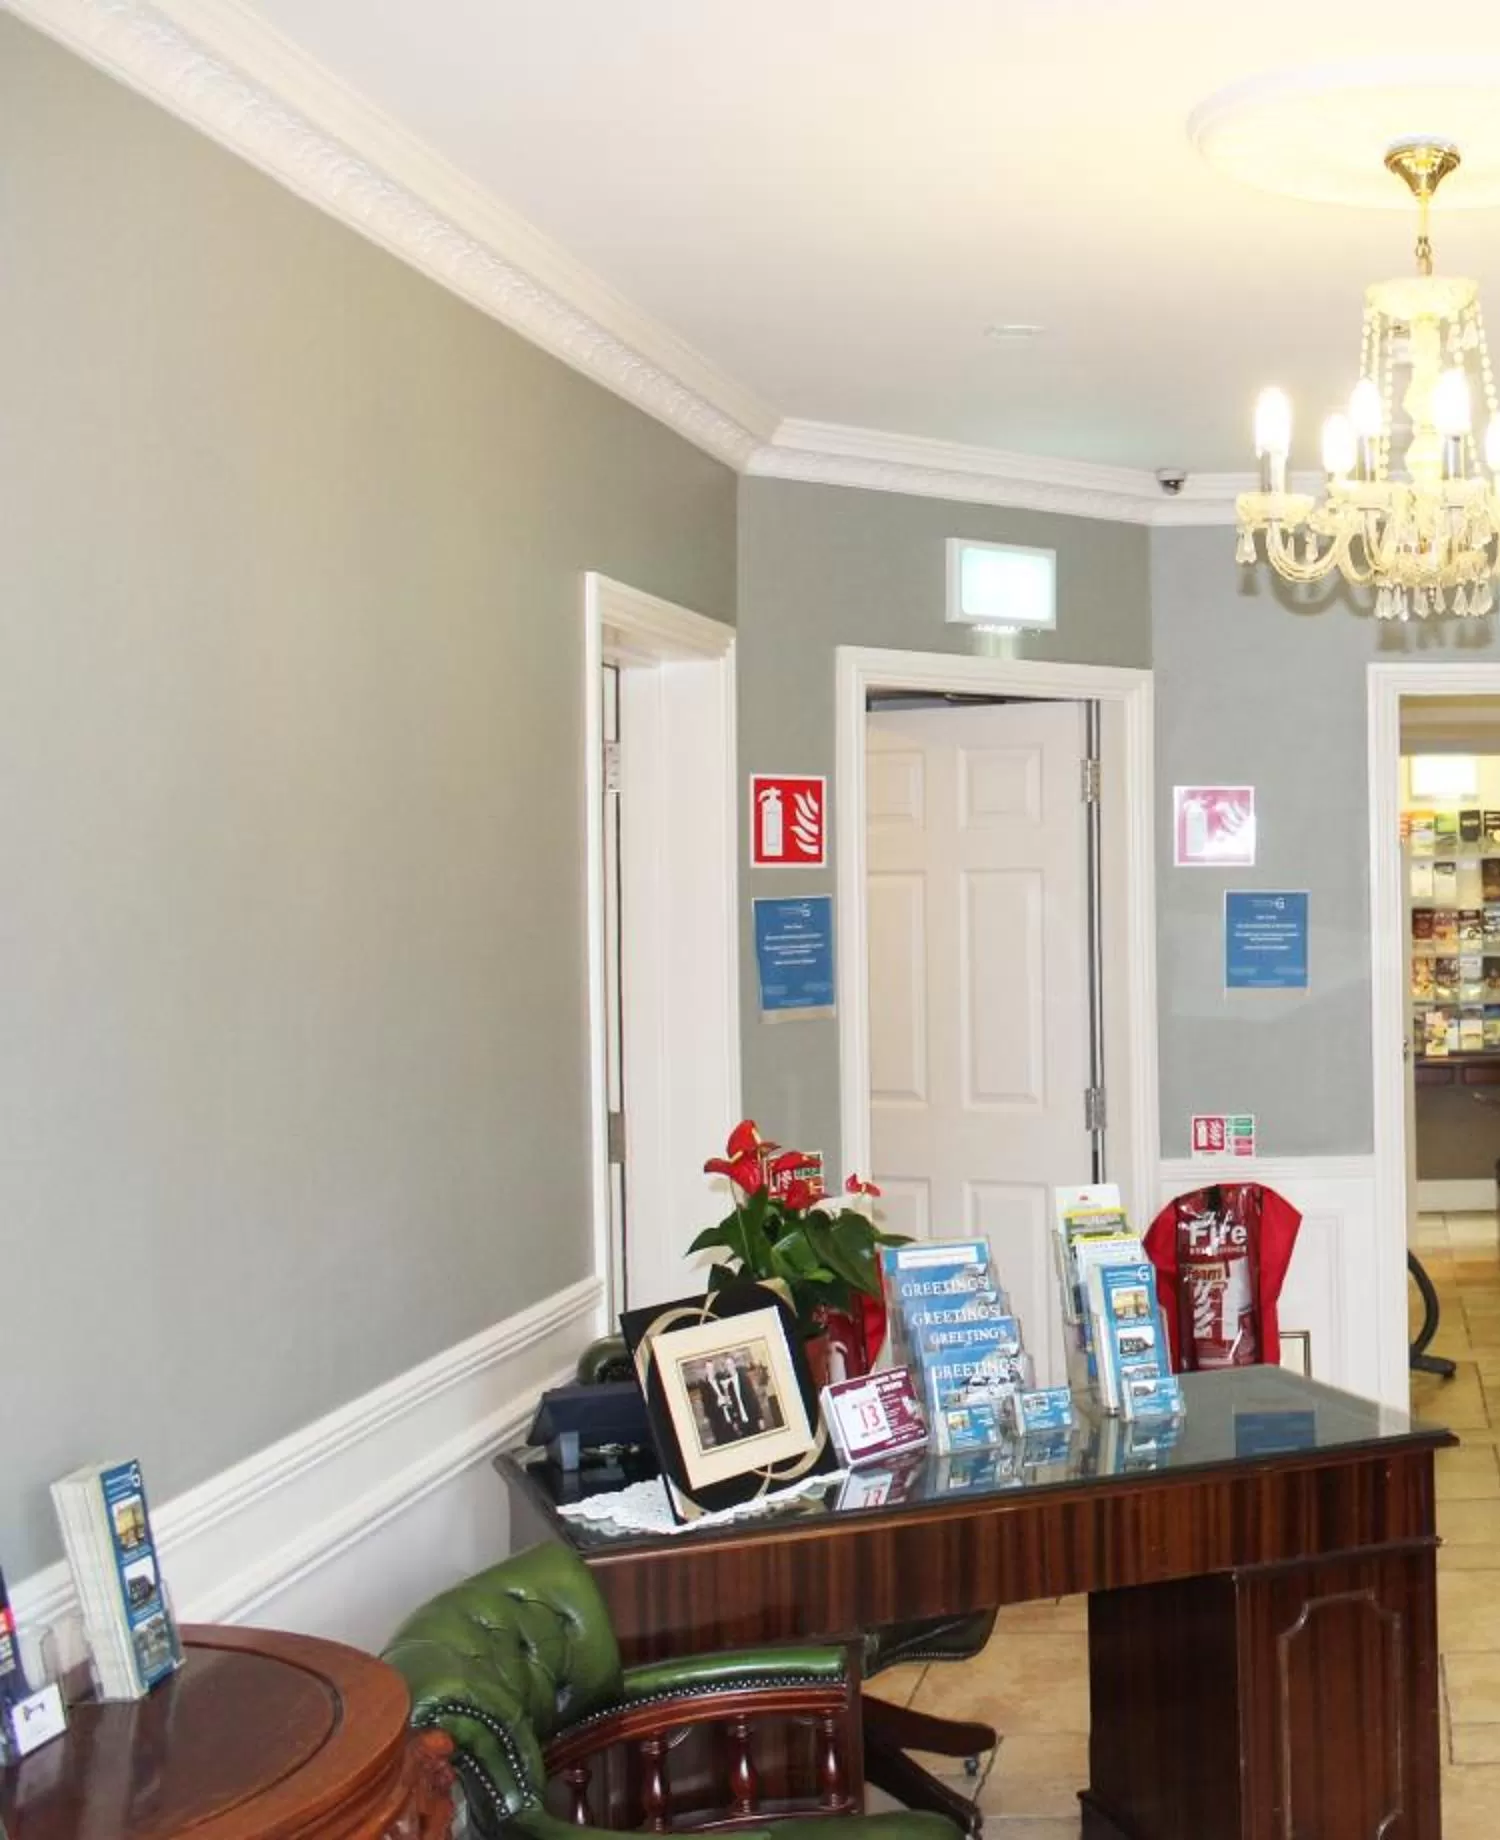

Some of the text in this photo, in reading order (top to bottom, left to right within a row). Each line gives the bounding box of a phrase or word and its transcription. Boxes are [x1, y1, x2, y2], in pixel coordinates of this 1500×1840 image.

[1189, 1220, 1248, 1246] Fire
[901, 1276, 989, 1297] GREETINGS
[911, 1305, 1001, 1326] GREETINGS
[930, 1325, 1008, 1345] GREETINGS
[932, 1355, 1025, 1379] GREETINGS
